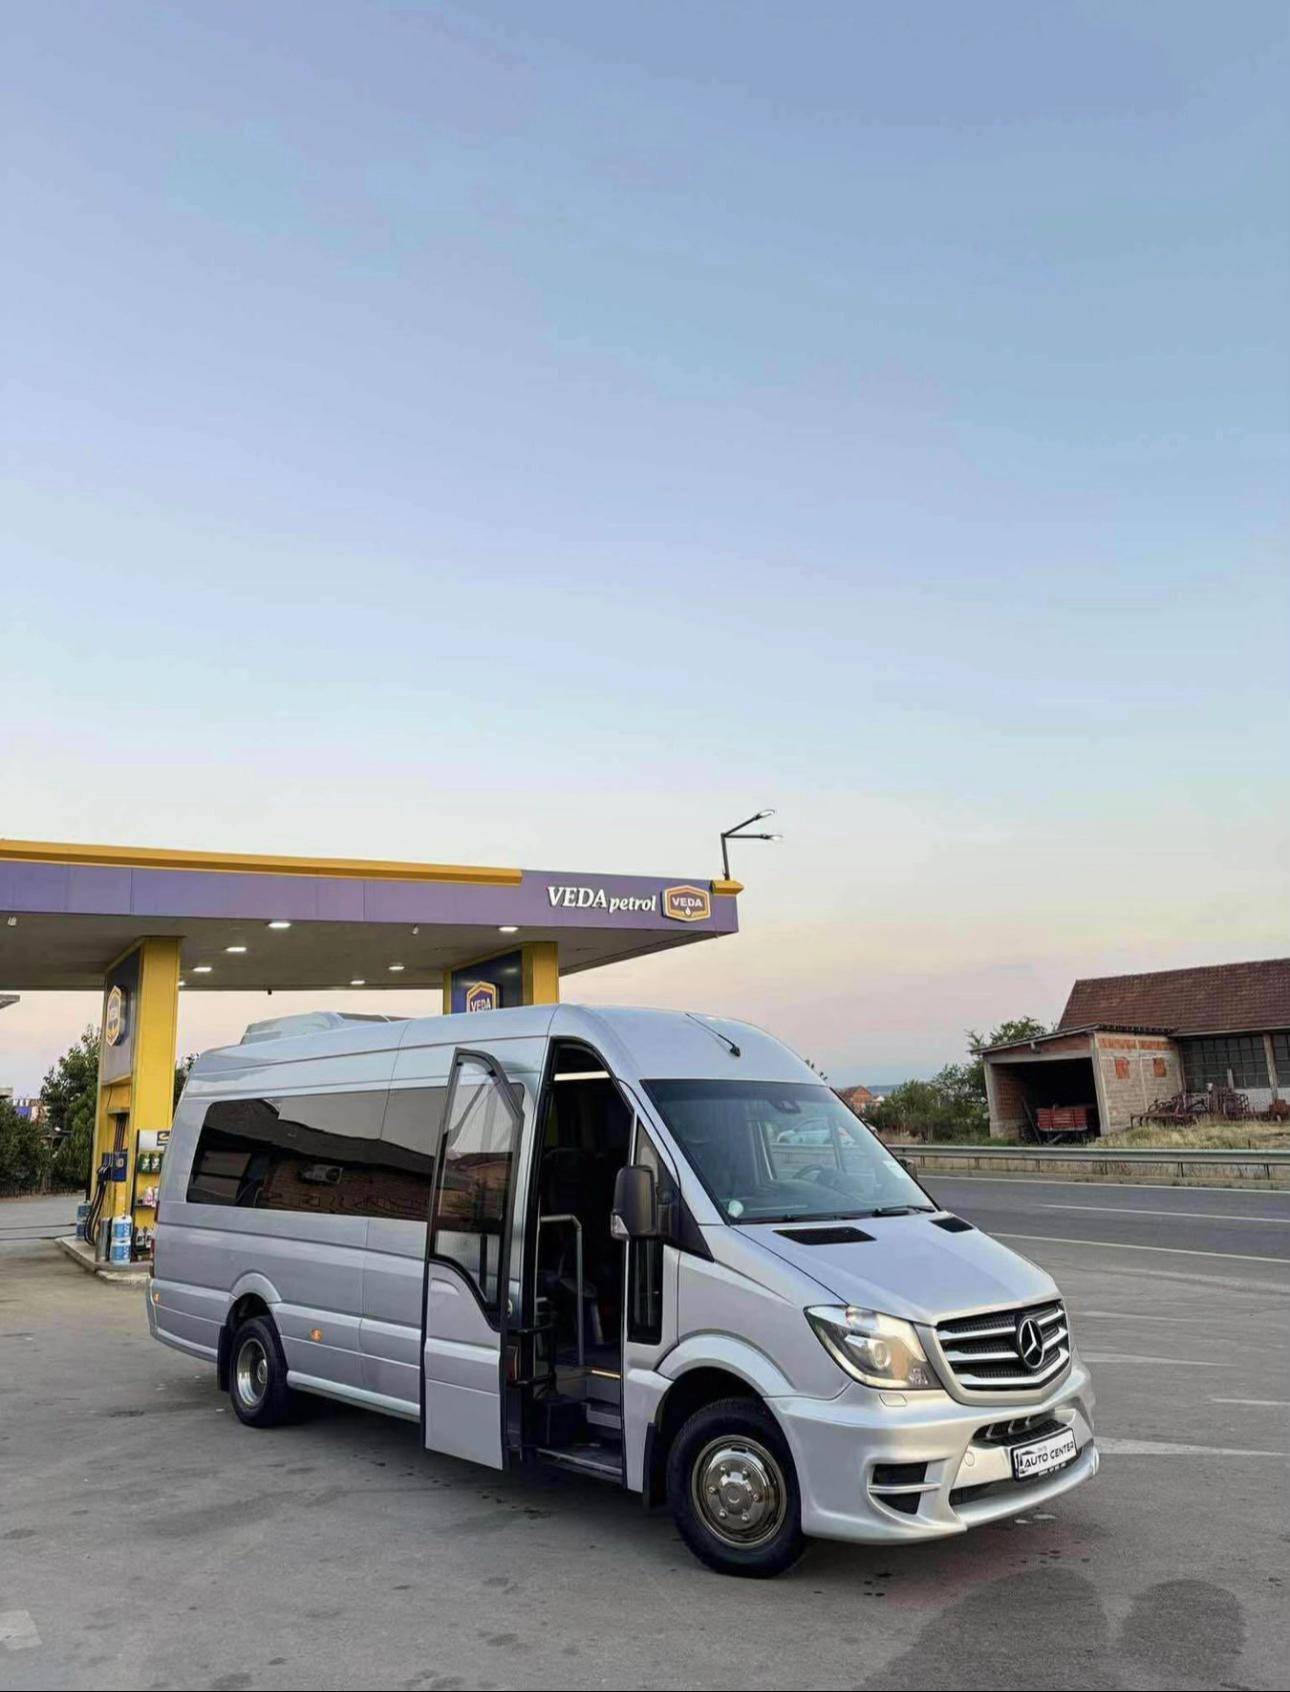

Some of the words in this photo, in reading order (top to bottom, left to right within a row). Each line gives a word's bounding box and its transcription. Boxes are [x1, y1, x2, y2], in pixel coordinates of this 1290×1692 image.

[547, 886, 607, 908] VEDA
[608, 895, 656, 914] petrol
[672, 896, 703, 908] VEDA
[1024, 1452, 1048, 1469] AUTO
[1049, 1441, 1074, 1460] CENTER
